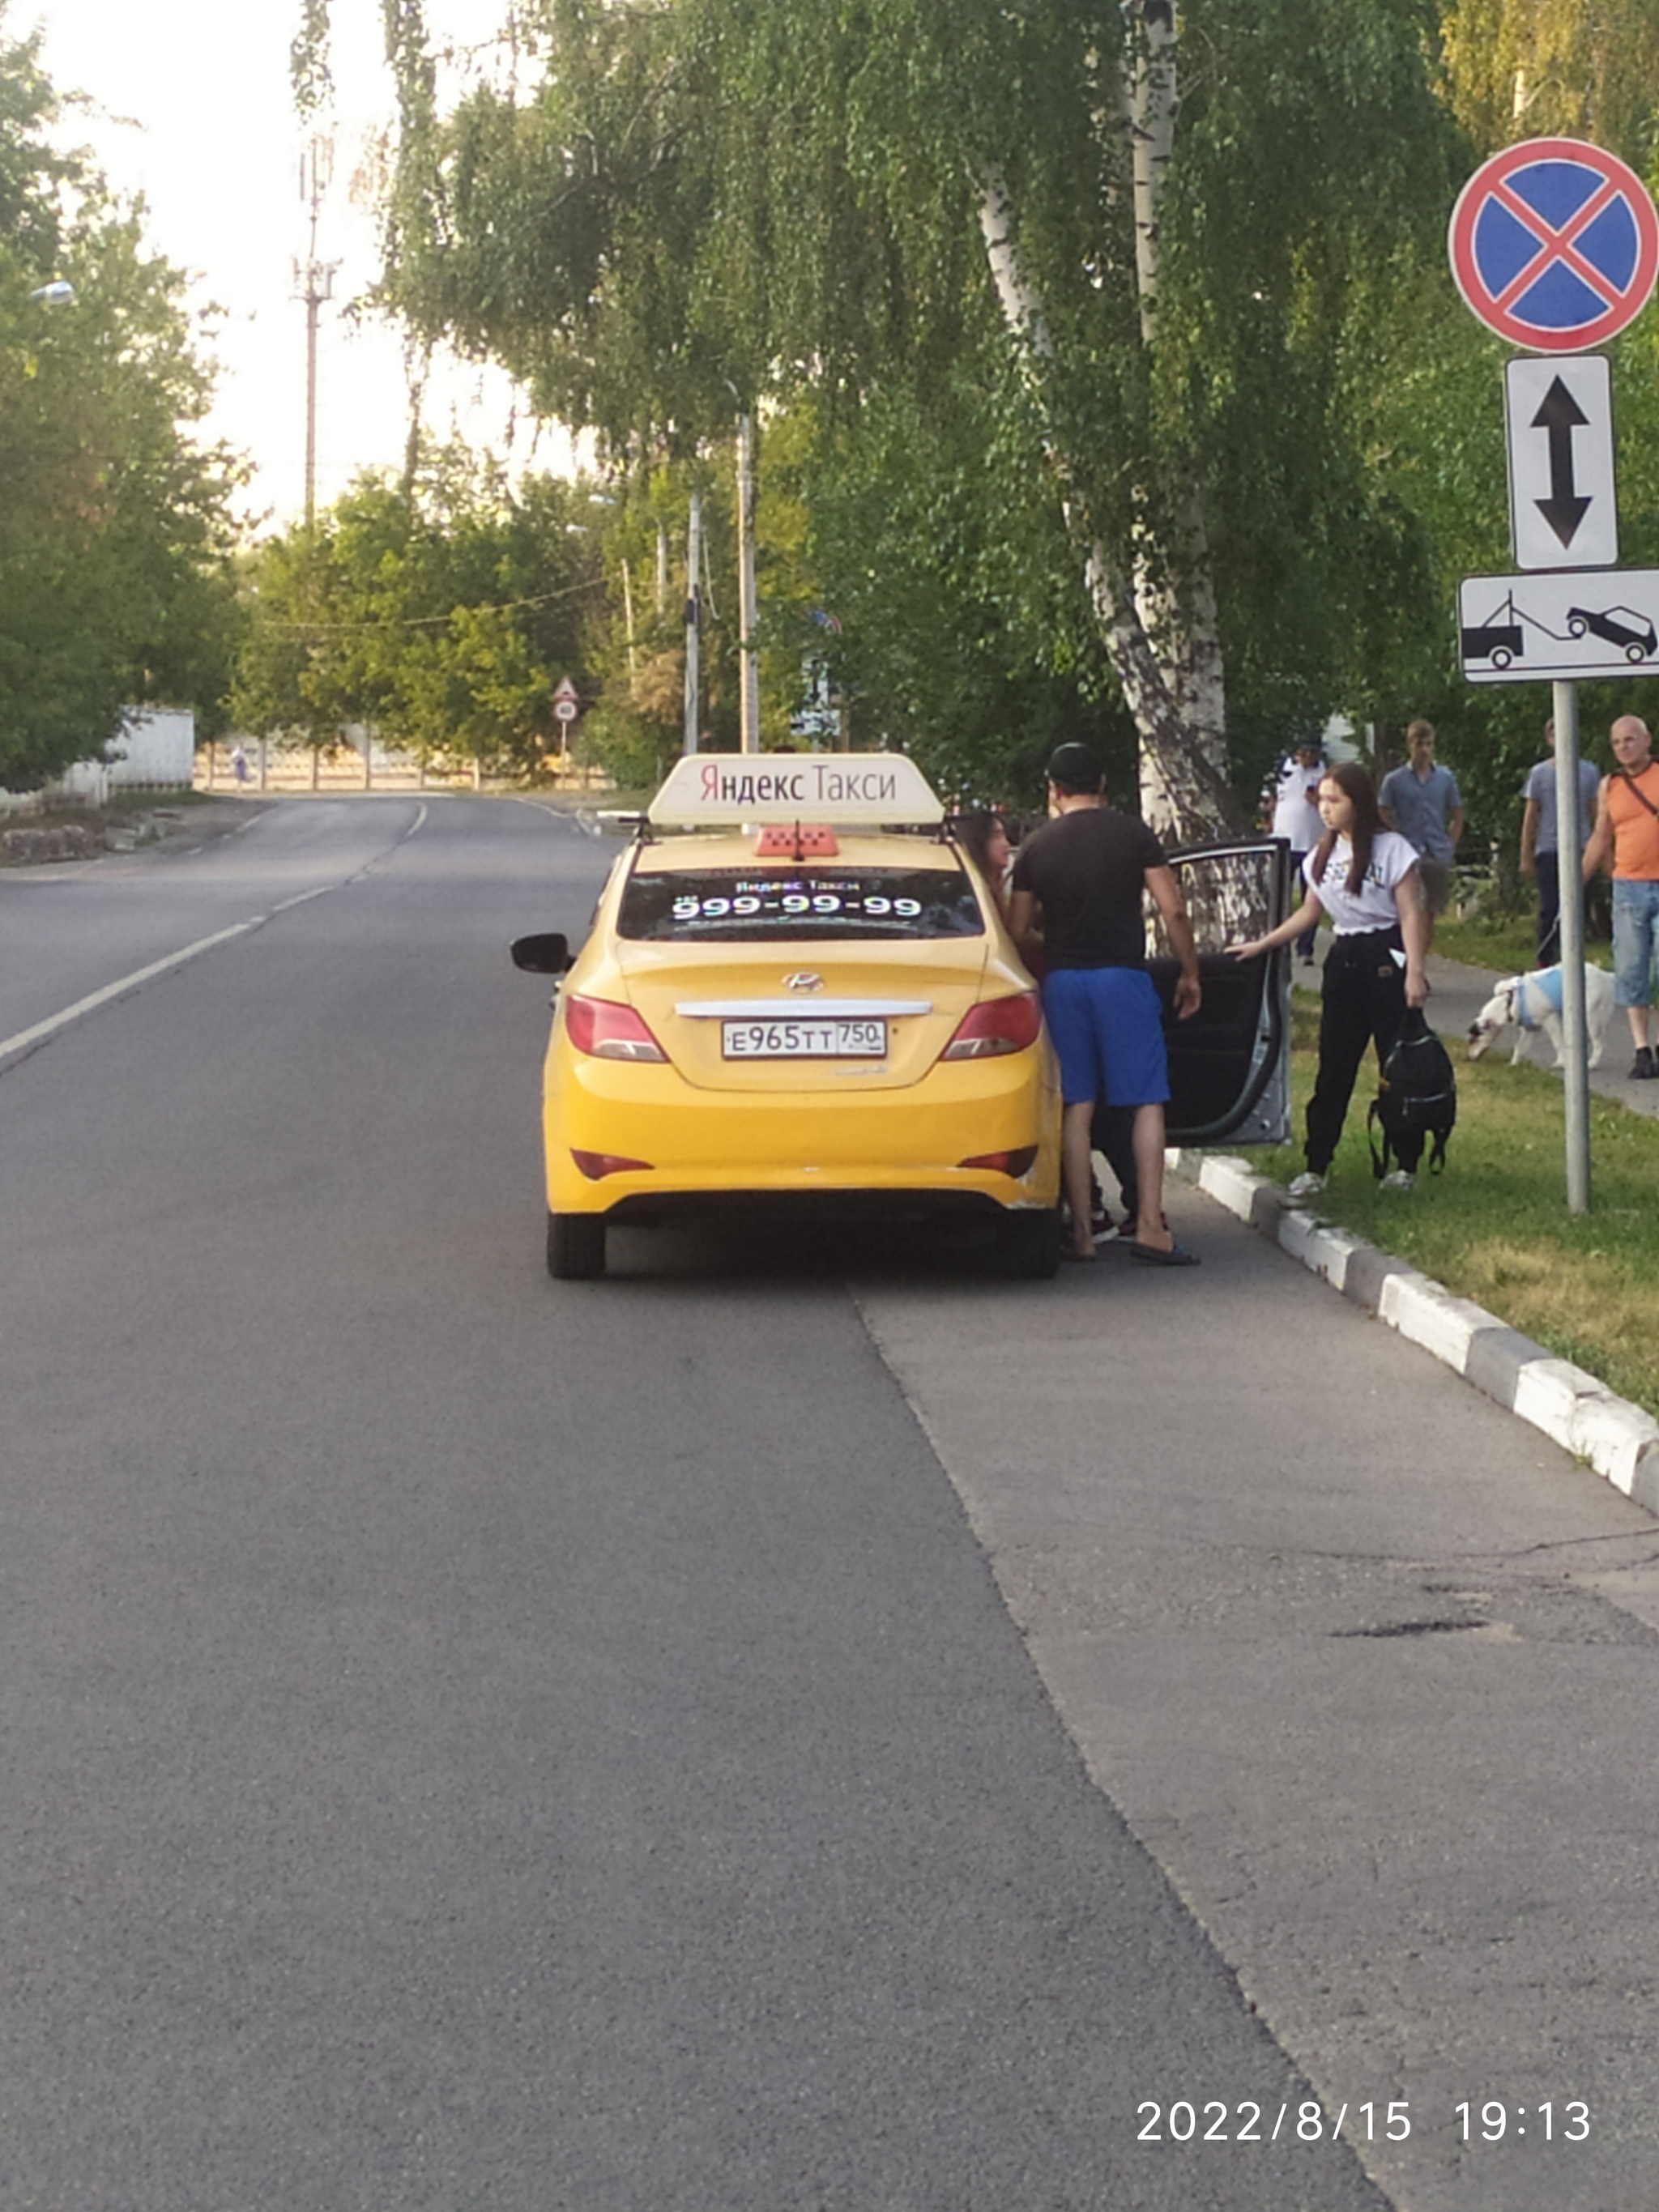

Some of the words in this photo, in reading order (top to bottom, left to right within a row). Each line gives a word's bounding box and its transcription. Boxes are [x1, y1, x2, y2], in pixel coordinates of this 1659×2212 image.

[701, 764, 804, 804] Яндекс
[812, 765, 896, 800] Такси
[672, 894, 922, 920] 999-99-99
[838, 1024, 878, 1043] 750
